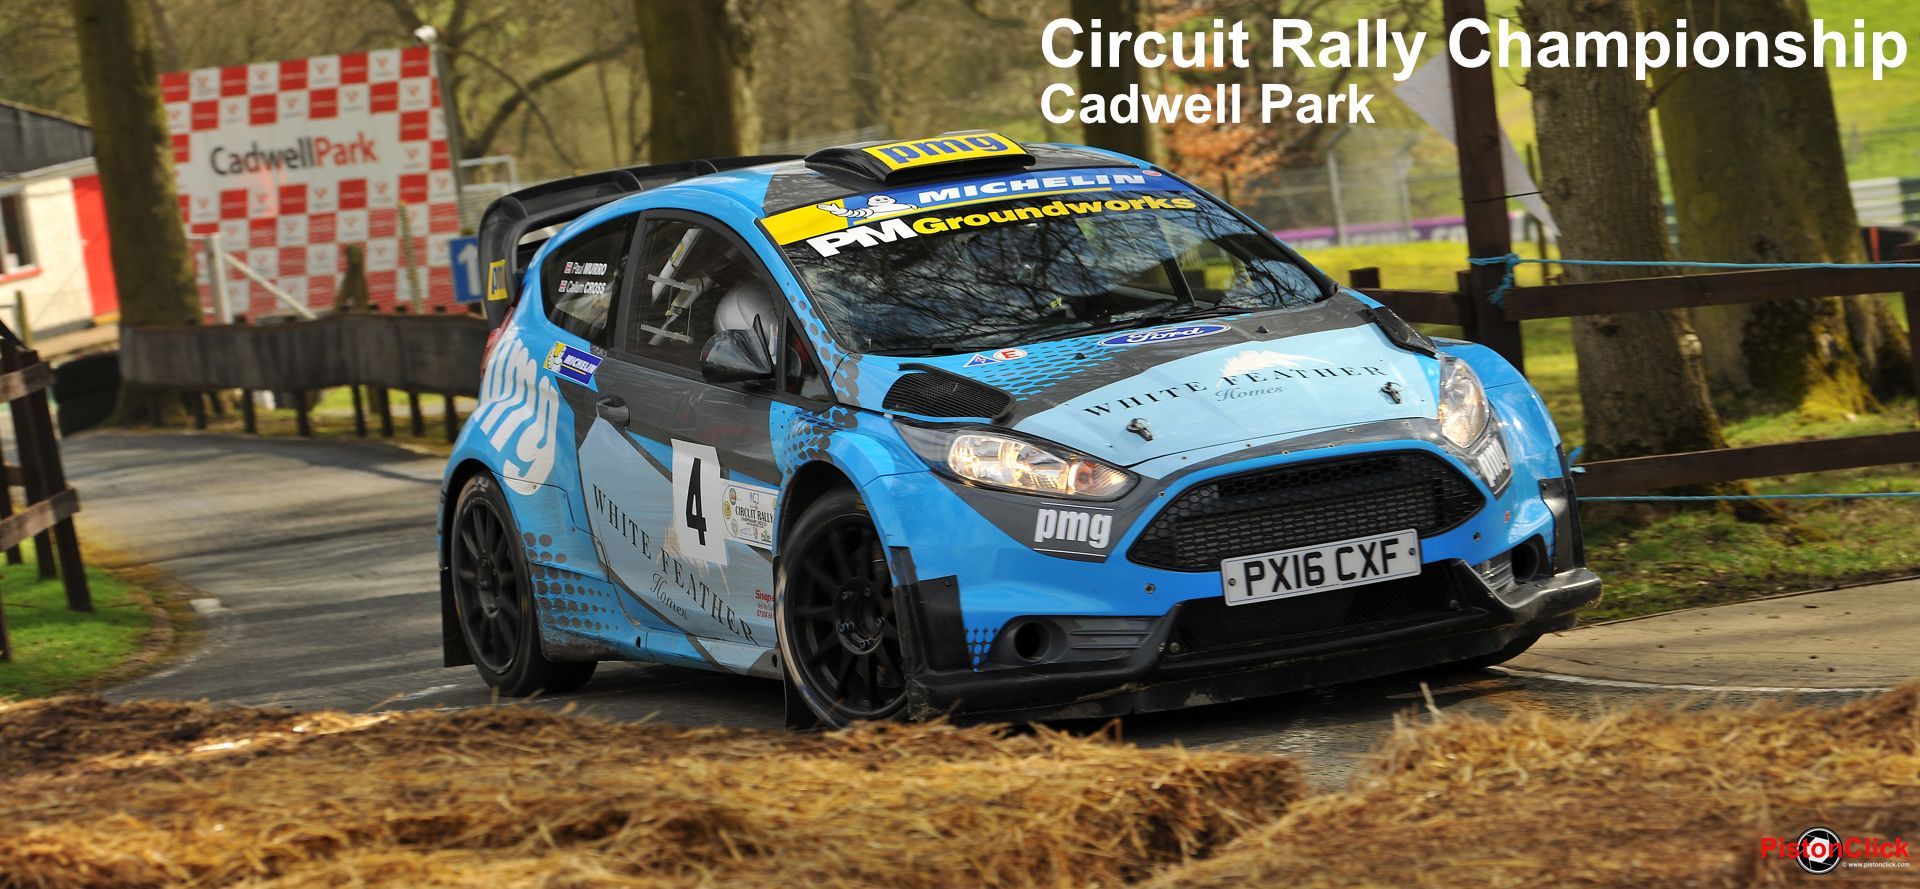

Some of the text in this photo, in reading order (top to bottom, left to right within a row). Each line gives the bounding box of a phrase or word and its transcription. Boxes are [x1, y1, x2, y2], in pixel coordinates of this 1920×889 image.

[878, 132, 1009, 164] pmg
[918, 174, 1146, 204] MICHELIN
[583, 281, 607, 295] CROSS
[1126, 327, 1204, 344] Ford
[563, 354, 598, 374] MICHELIN
[1084, 365, 1388, 418] WHITE FEATHER
[1215, 385, 1284, 402] Homes
[686, 457, 707, 546] 4
[1034, 508, 1113, 549] pmg
[593, 483, 761, 647] WHITE FEATHER
[1243, 538, 1399, 597] PX16 CXF
